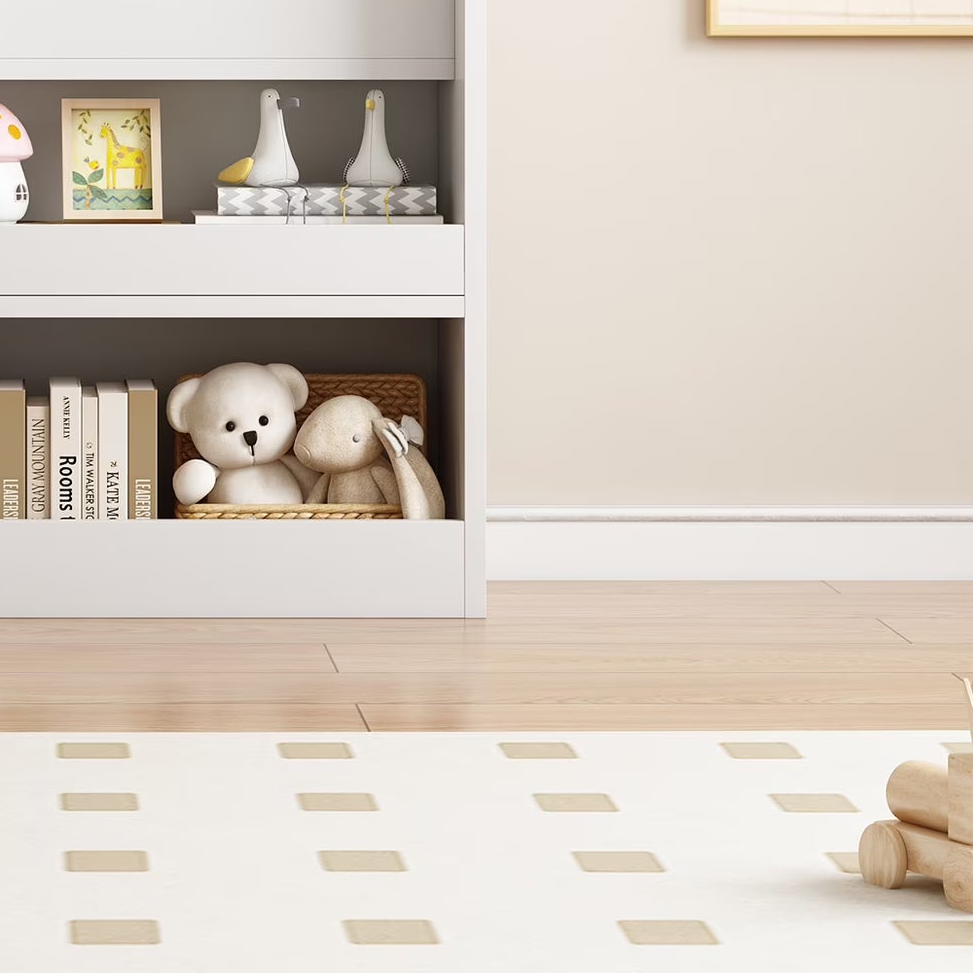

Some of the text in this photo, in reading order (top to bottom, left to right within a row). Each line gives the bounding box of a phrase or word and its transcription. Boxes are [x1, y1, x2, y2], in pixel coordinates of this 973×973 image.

[31, 418, 45, 512] GRAY MOUNTAIN
[85, 453, 94, 467] TIM
[3, 479, 19, 520] LEADERS
[59, 456, 77, 511] Rooms
[85, 469, 94, 504] WALKER
[106, 472, 119, 503] KATE
[135, 479, 151, 520] LEADERS
